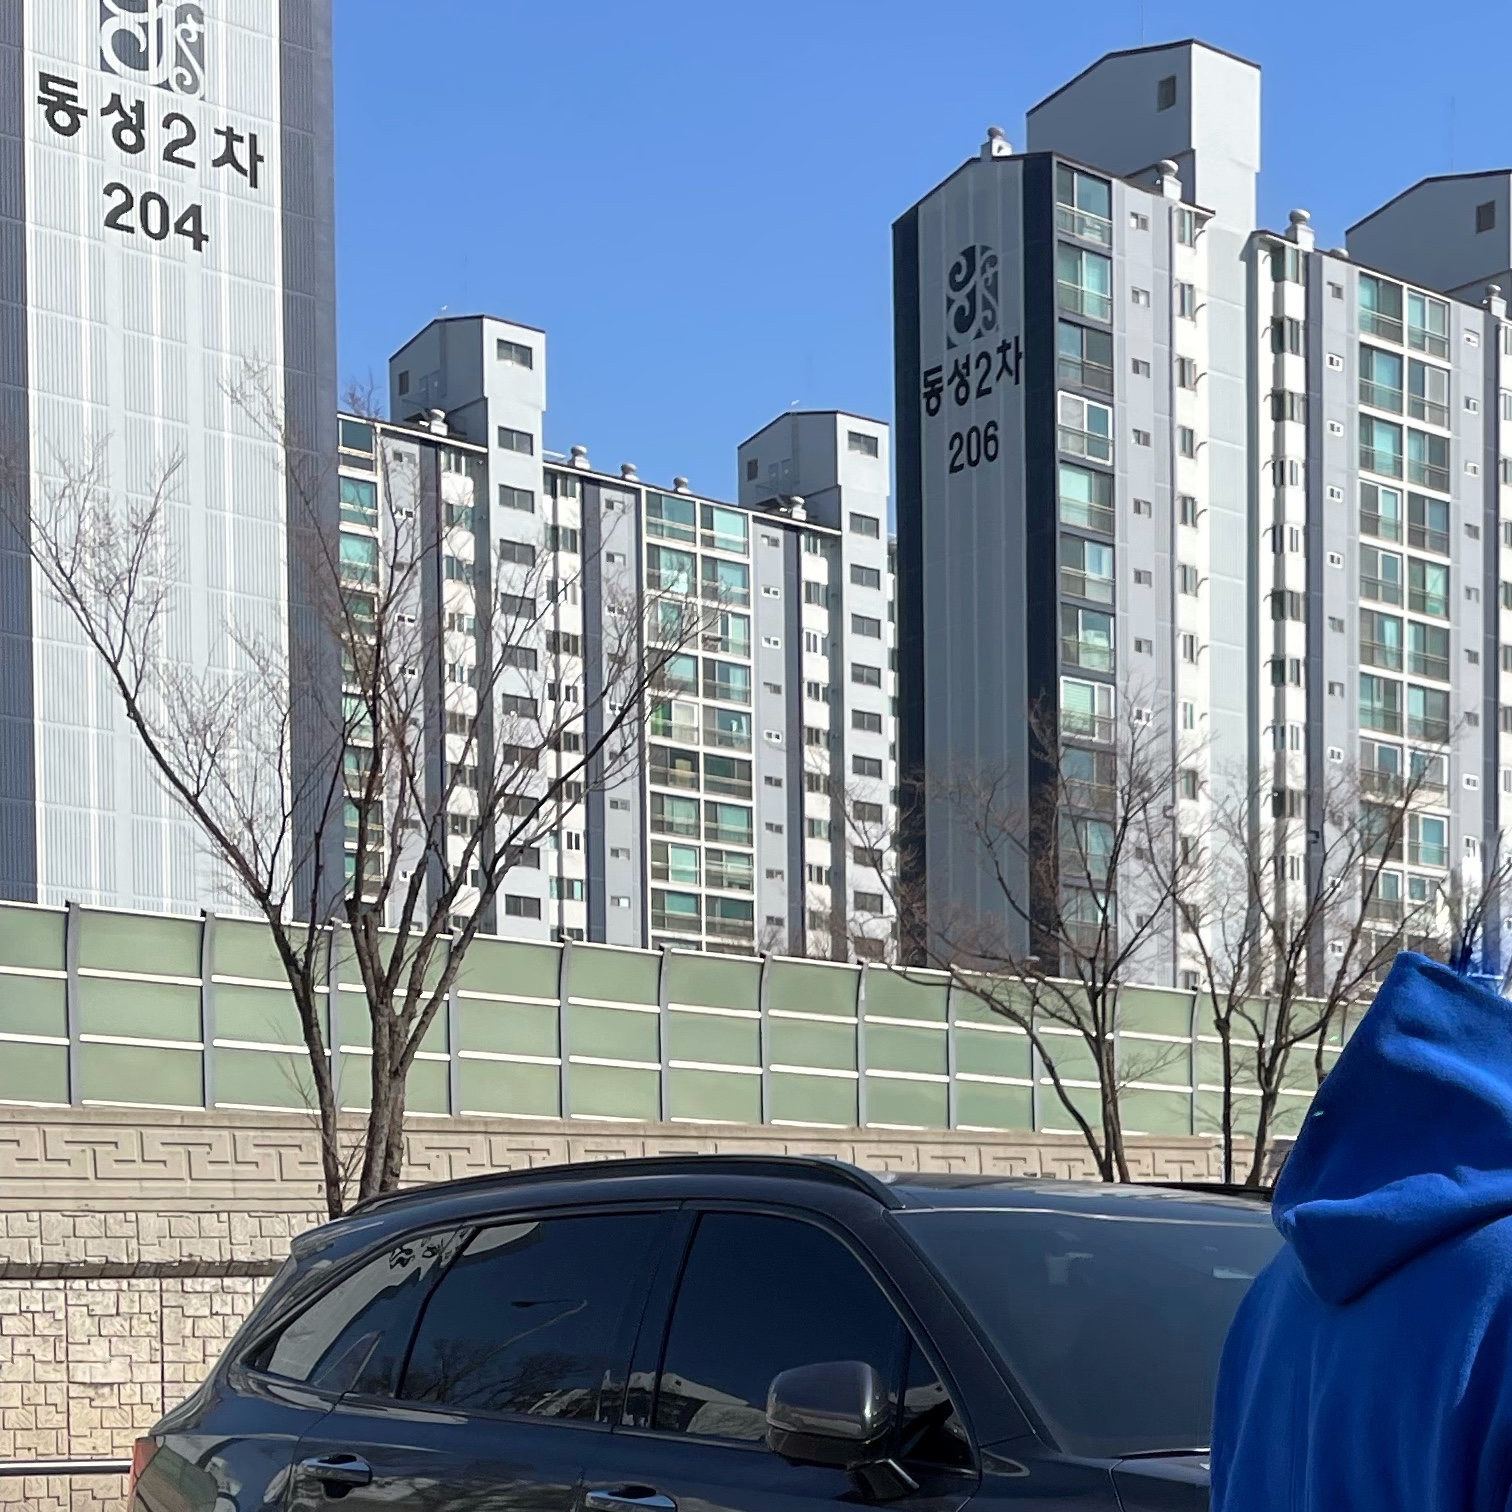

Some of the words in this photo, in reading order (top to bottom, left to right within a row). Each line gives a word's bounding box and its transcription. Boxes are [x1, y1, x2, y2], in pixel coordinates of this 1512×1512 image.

[37, 71, 265, 189] 동성2차
[102, 181, 209, 253] 204
[922, 335, 1024, 417] 동성2차
[948, 419, 1000, 475] 206
